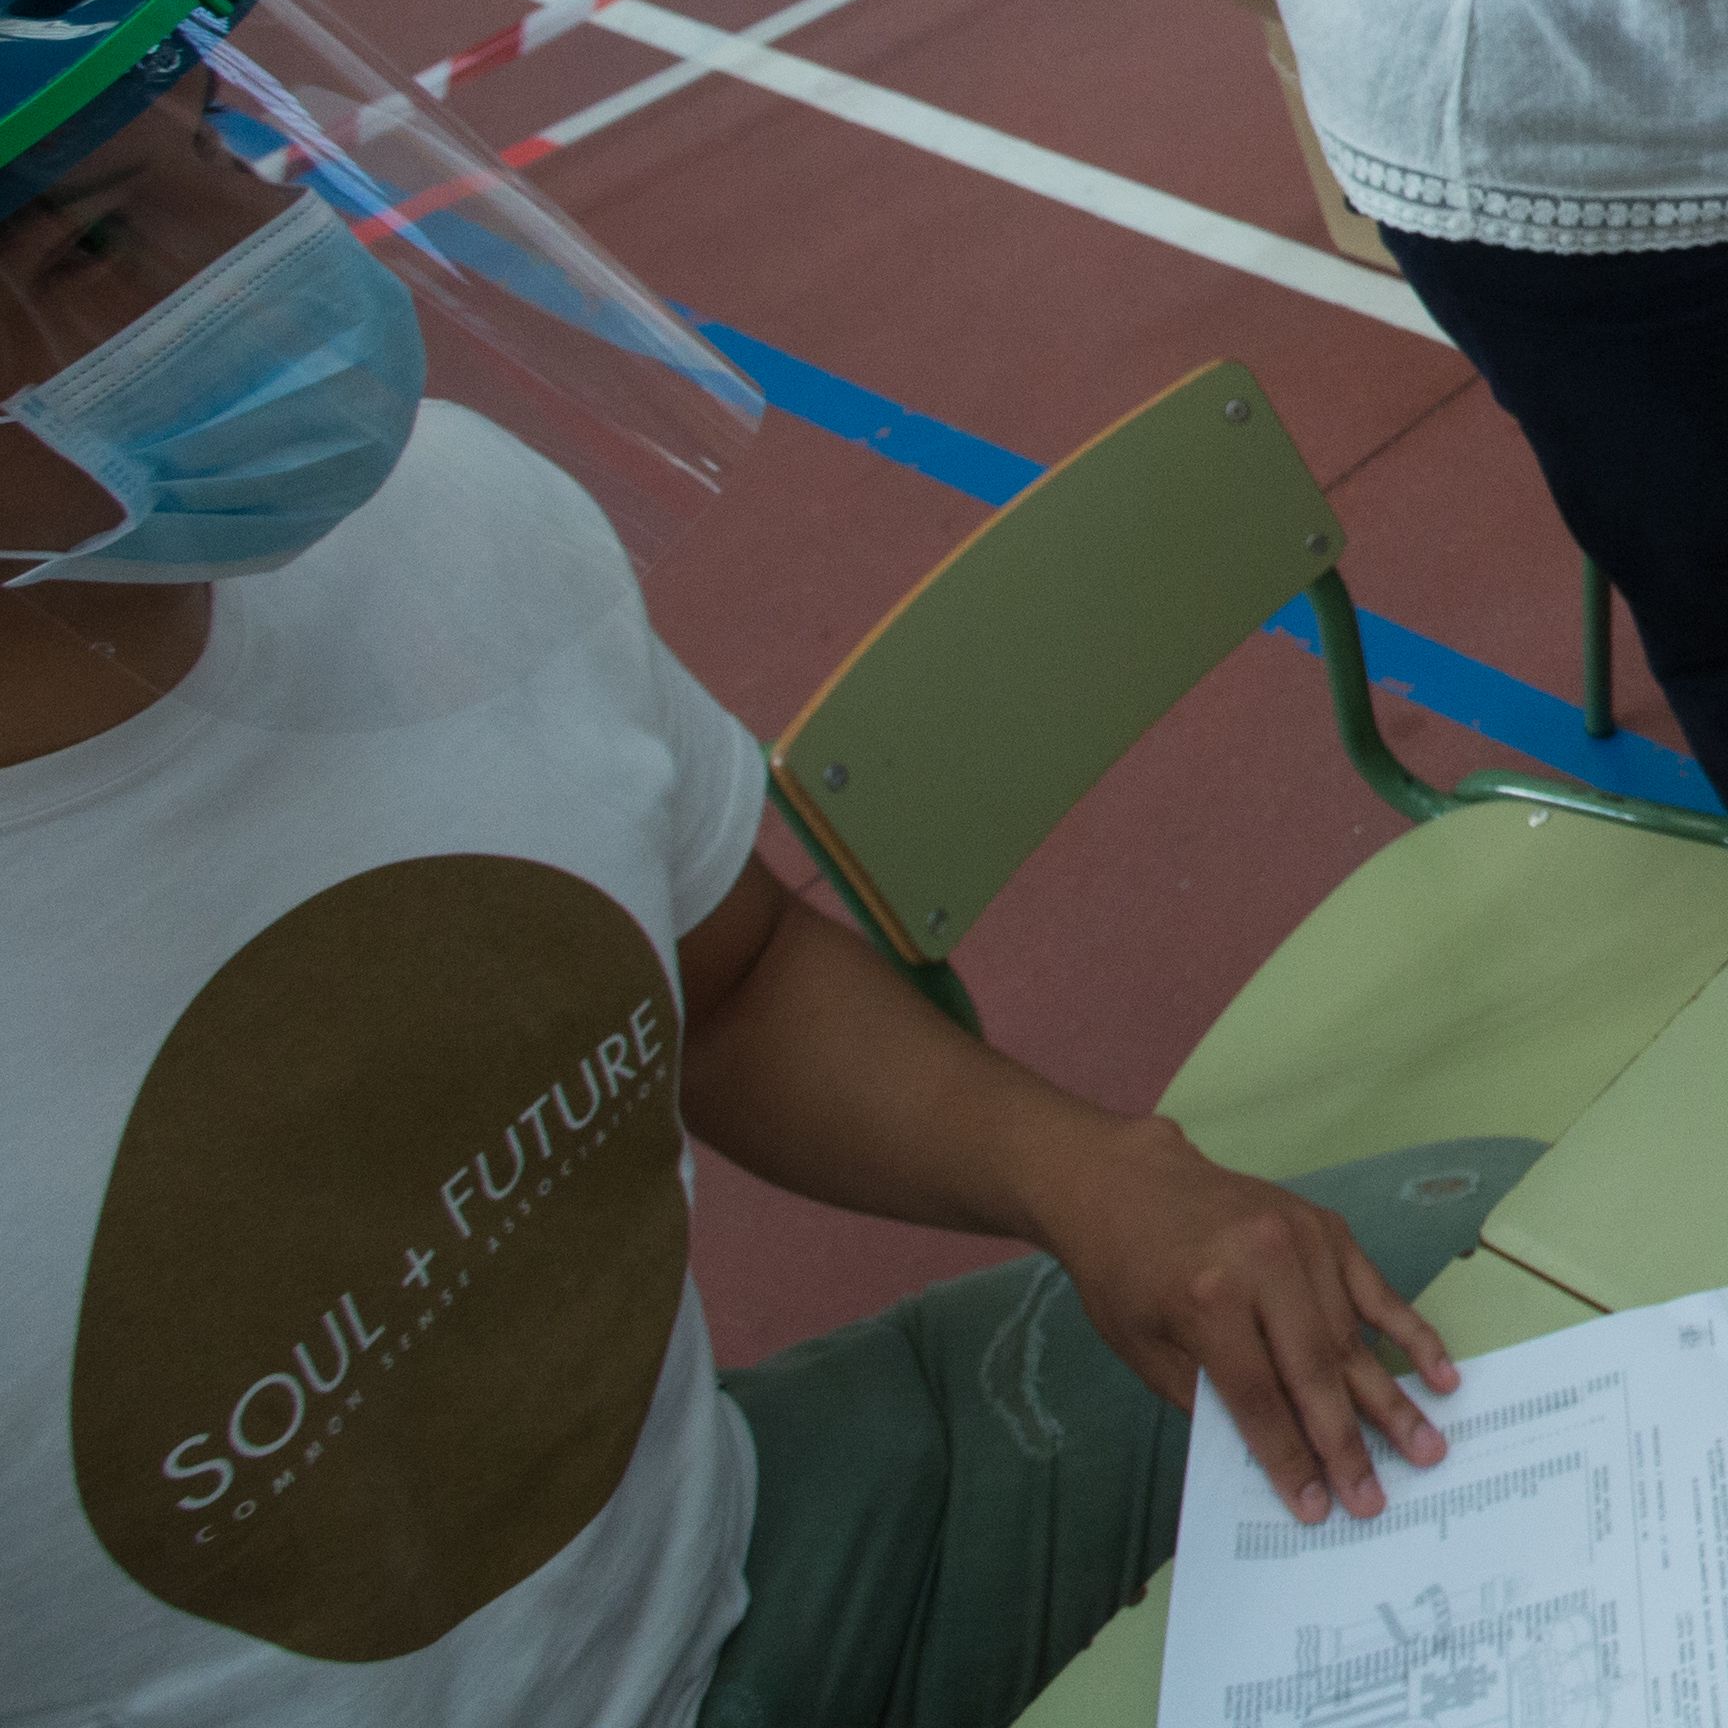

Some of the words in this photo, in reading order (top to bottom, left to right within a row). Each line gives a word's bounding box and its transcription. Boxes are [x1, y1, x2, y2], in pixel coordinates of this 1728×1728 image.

[160, 1290, 388, 1514] SOUL
[400, 1245, 439, 1290] +
[436, 997, 667, 1241] FUTURE
[192, 1388, 366, 1546] COMMON
[378, 1267, 473, 1373] SENSE
